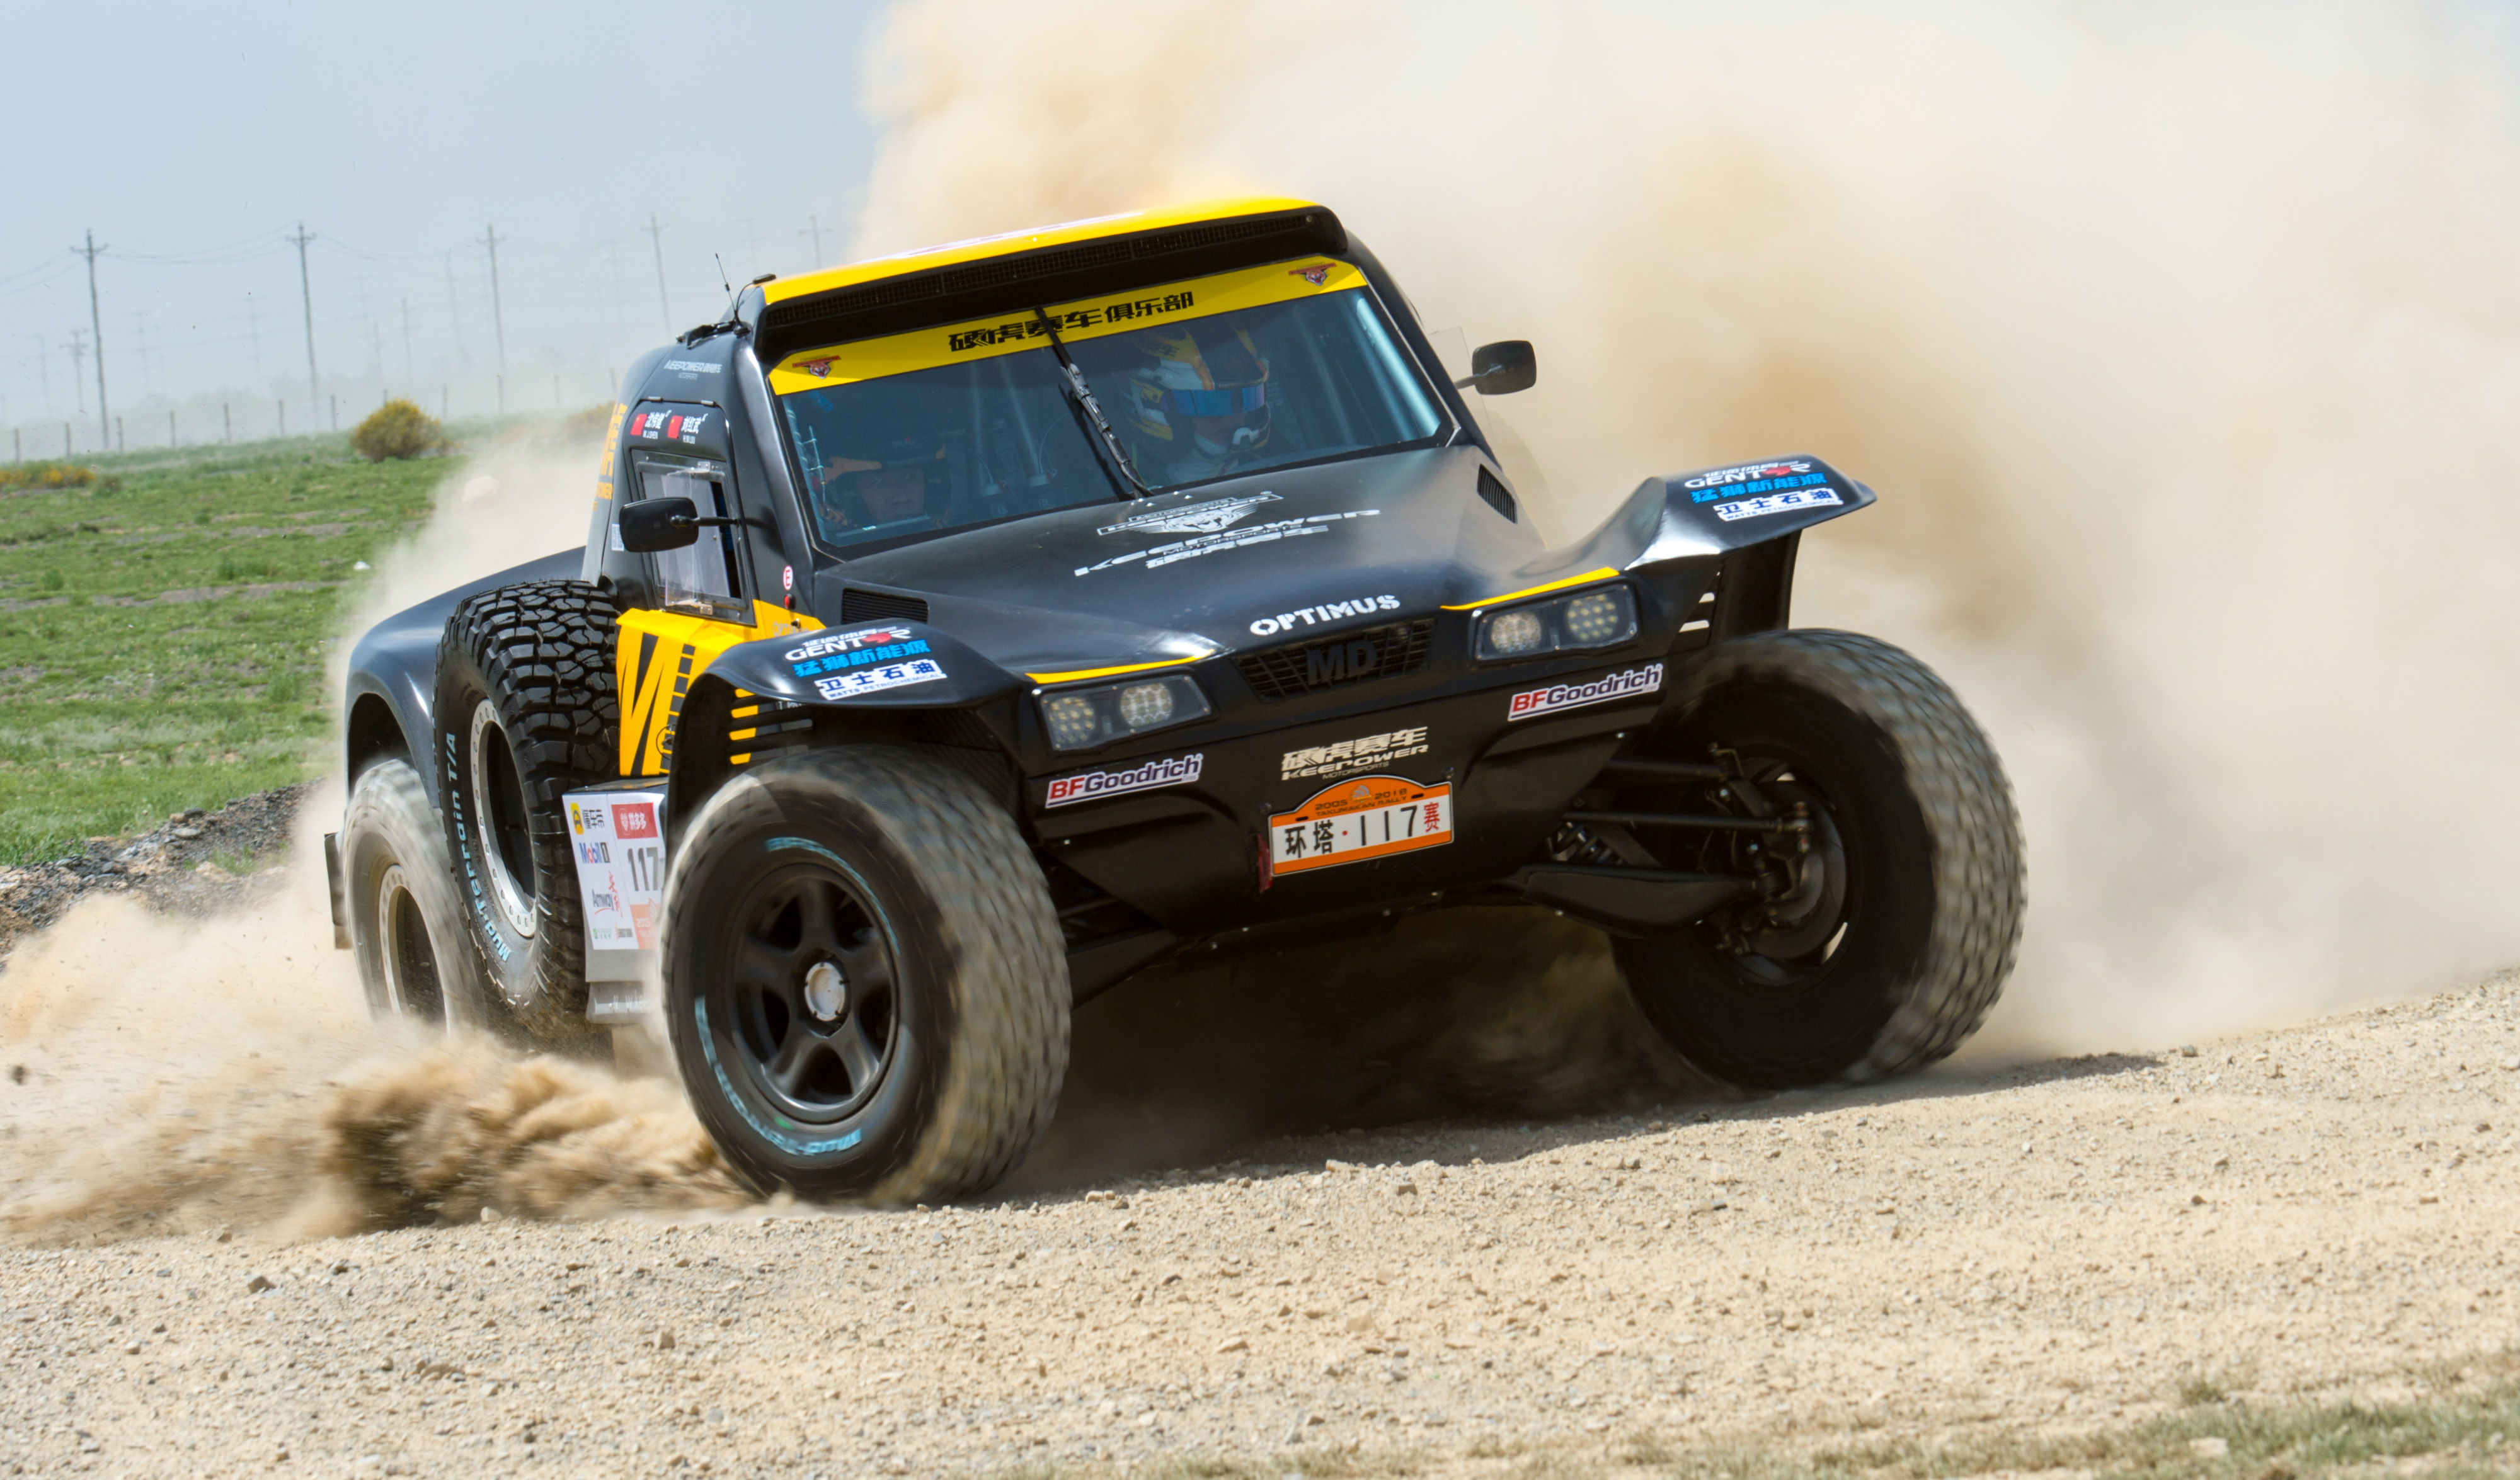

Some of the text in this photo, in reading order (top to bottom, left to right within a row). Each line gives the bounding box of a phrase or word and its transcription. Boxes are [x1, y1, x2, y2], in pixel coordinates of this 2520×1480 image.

[1690, 472, 1828, 504] 猛狮新能源
[1718, 490, 1833, 515] 卫士石油
[1726, 511, 1758, 520] WATTS
[1074, 509, 1382, 576] KEEPOWER
[1163, 524, 1302, 555] MOTORSPORTS
[1249, 595, 1401, 635] OPTIMUS
[793, 639, 932, 677] 猛狮新能源
[1307, 640, 1377, 686] MD
[821, 662, 936, 692] 卫士石油
[828, 673, 941, 698] WATTS PETROCHEMICAL
[1513, 668, 1659, 712] BFGoodrich
[446, 732, 458, 782] T/A
[1281, 744, 1429, 780] KEEPOWER
[1322, 761, 1390, 779] MOTORSPORTS
[1050, 755, 1198, 800] BFGoodrich
[1315, 799, 1348, 811] 2005
[1375, 788, 1407, 801] 2018
[1378, 796, 1407, 807] RALLY
[579, 843, 602, 863] Mobil
[627, 846, 660, 892] 117
[452, 789, 512, 964] Mud-Terrain
[592, 889, 614, 911] Amway
